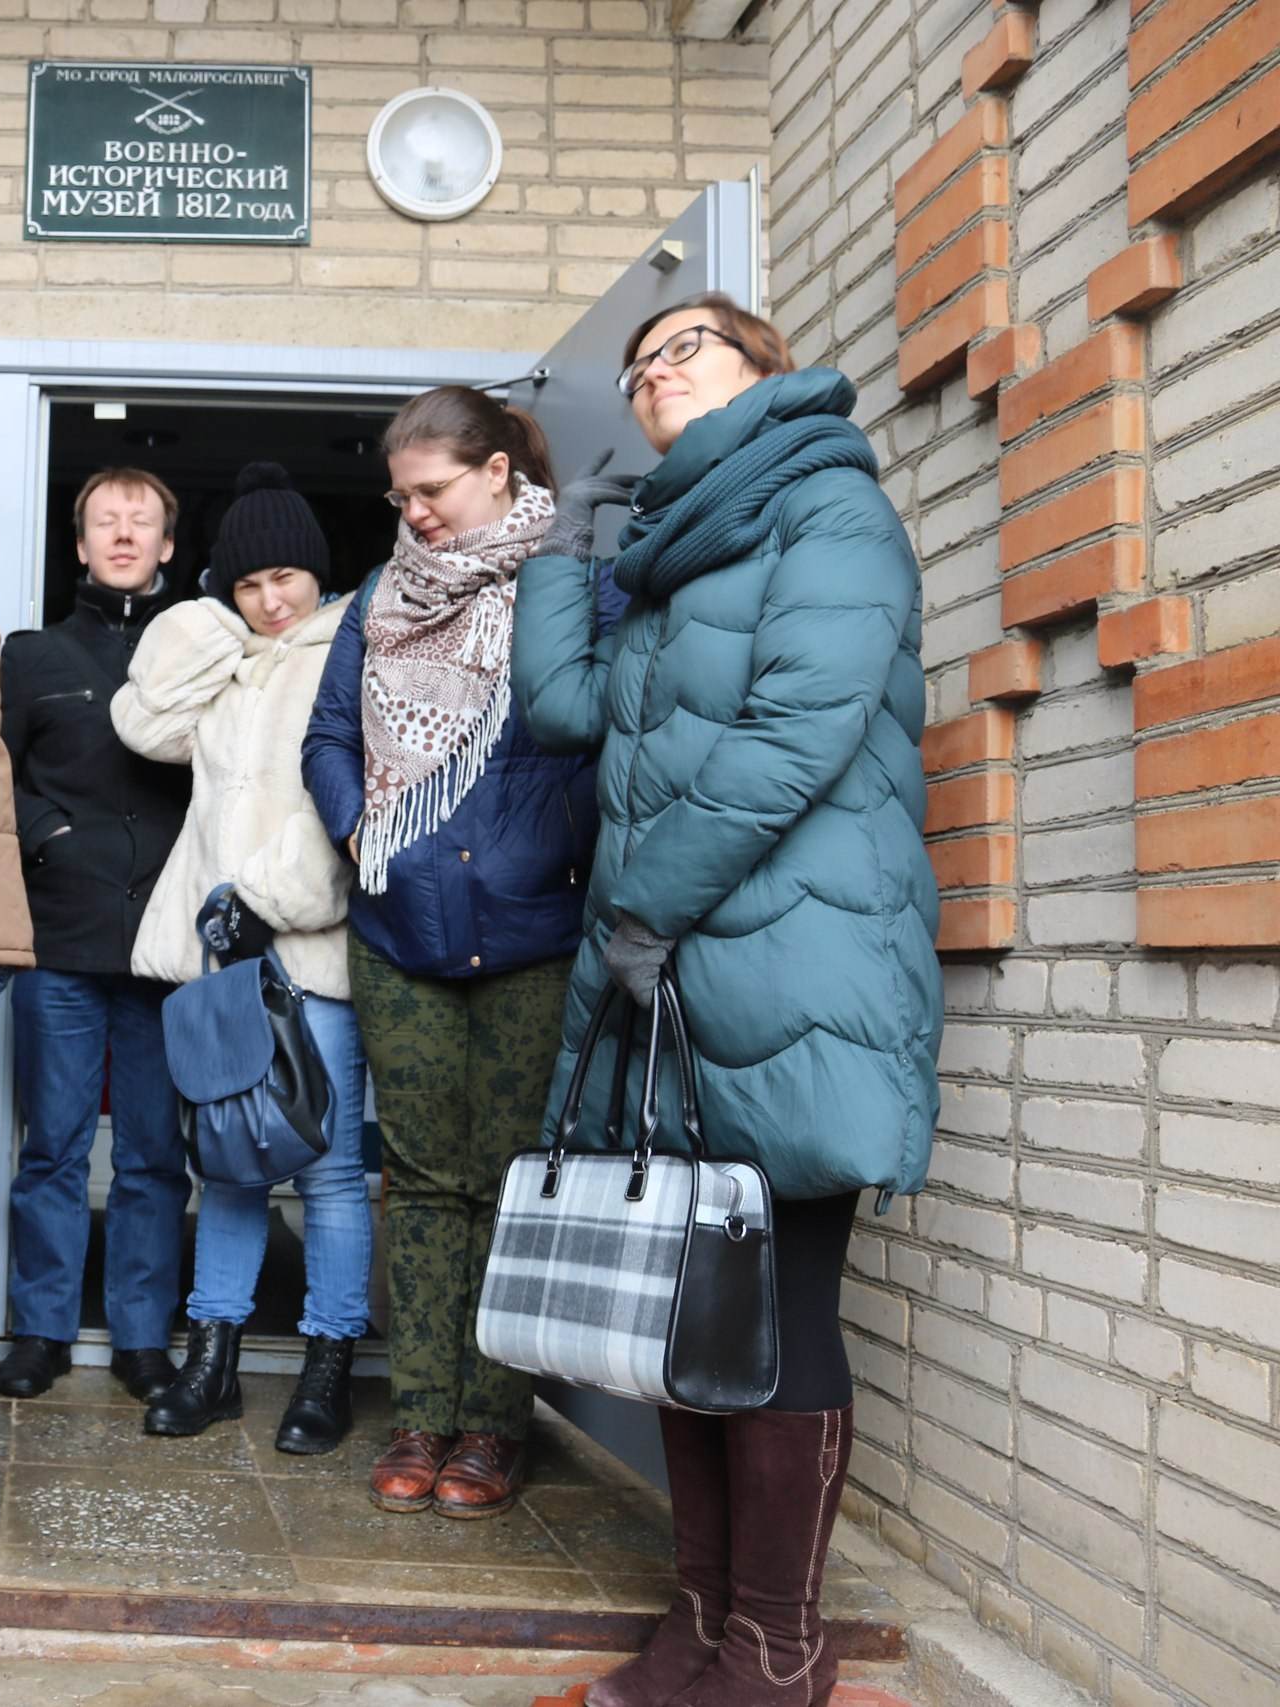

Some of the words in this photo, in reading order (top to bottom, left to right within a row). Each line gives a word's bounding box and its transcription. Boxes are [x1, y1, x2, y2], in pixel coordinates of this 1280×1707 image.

[56, 69, 83, 82] МО
[157, 113, 181, 126] 1812
[104, 140, 247, 165] ВОЕННО-
[48, 164, 289, 190] ИСТОРИЧЕСКИЙ
[41, 186, 162, 217] МУЗЕЙ
[175, 192, 232, 219] 1812
